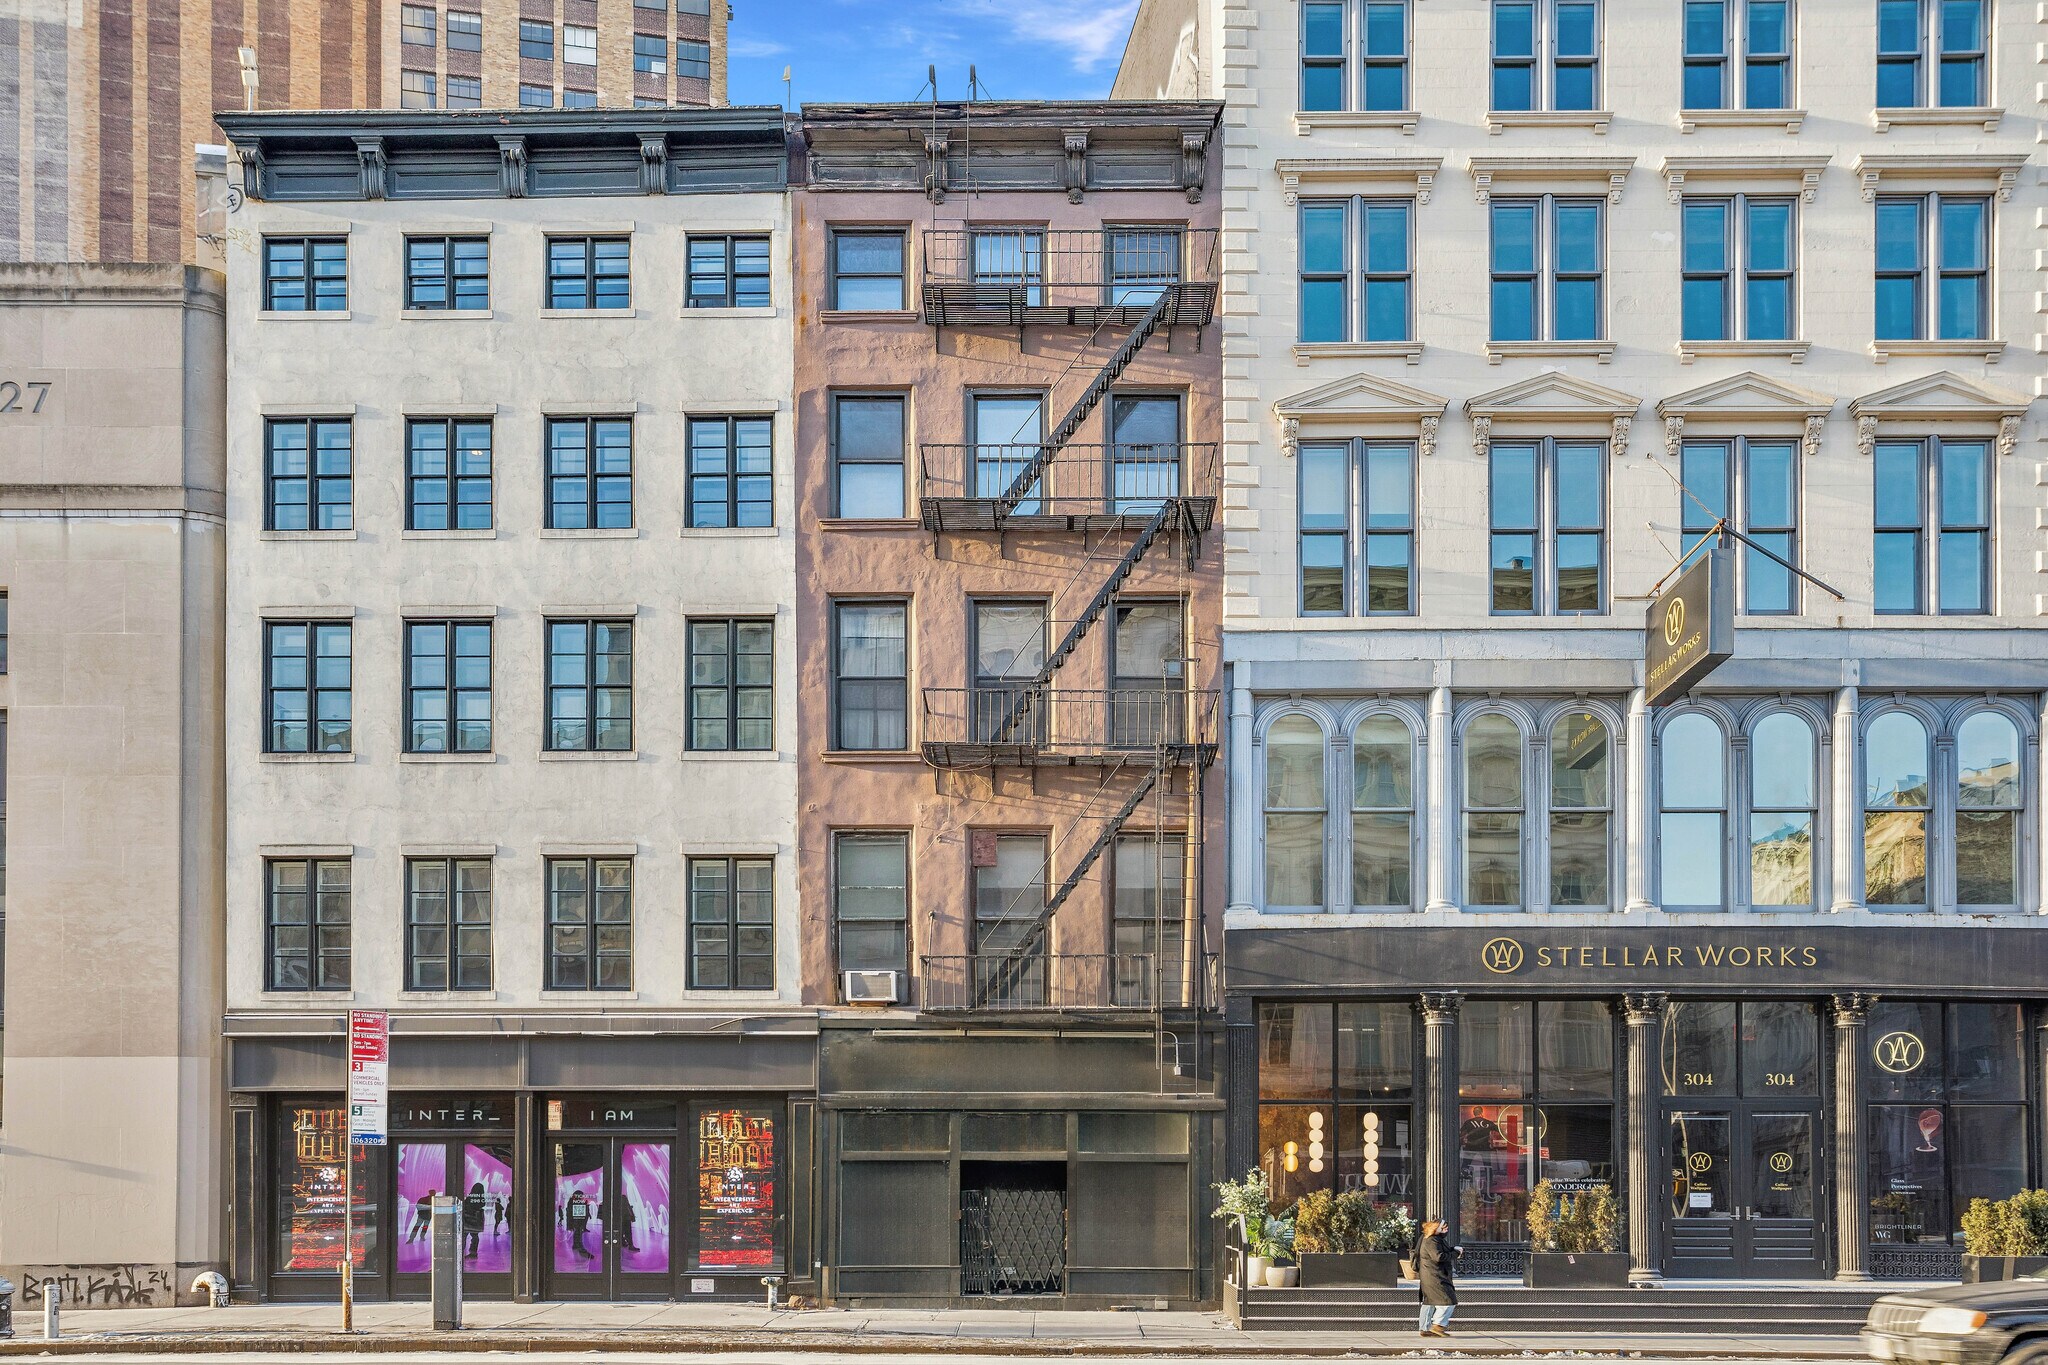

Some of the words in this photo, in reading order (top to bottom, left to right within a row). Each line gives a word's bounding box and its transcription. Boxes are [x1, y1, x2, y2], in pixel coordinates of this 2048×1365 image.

[1650, 652, 1677, 683] STELLAR
[1676, 631, 1701, 659] WORKS
[1537, 944, 1684, 967] STELLAR
[1695, 943, 1817, 967] WORKS
[354, 1062, 361, 1071] 3
[1684, 1073, 1713, 1086] 304
[1765, 1073, 1795, 1086] 304
[354, 1106, 361, 1115] 5
[605, 1110, 633, 1121] AM
[1875, 1230, 1891, 1239] WG
